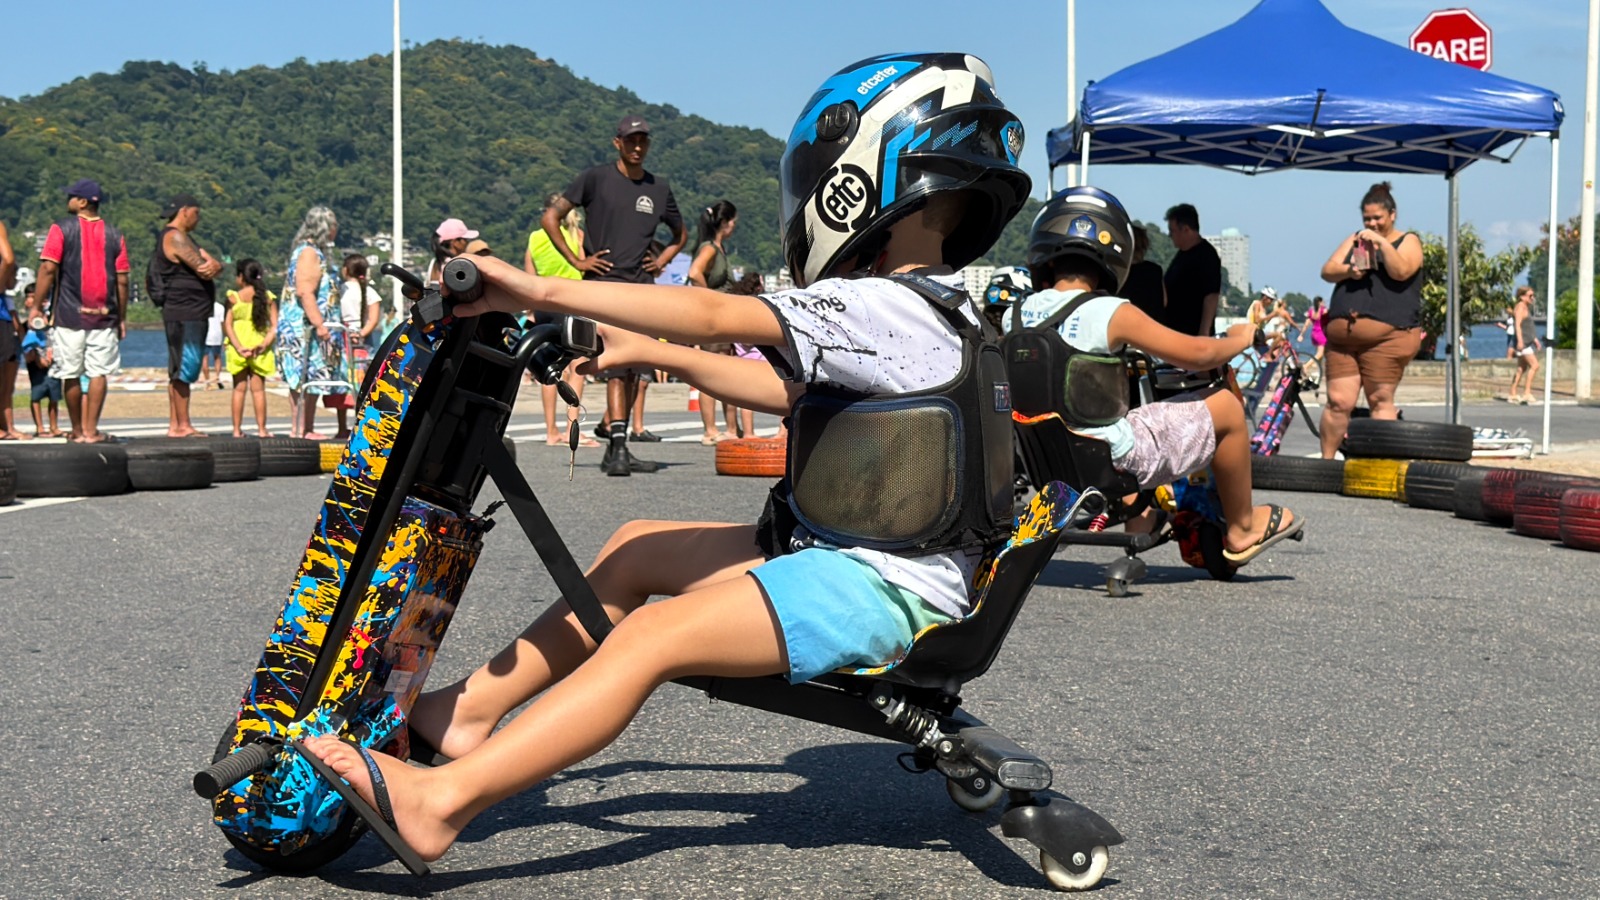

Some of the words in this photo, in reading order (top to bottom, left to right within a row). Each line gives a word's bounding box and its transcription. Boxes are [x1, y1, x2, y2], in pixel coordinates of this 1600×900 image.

[1416, 36, 1485, 62] PARE
[857, 65, 898, 95] etceter
[825, 176, 865, 220] etc
